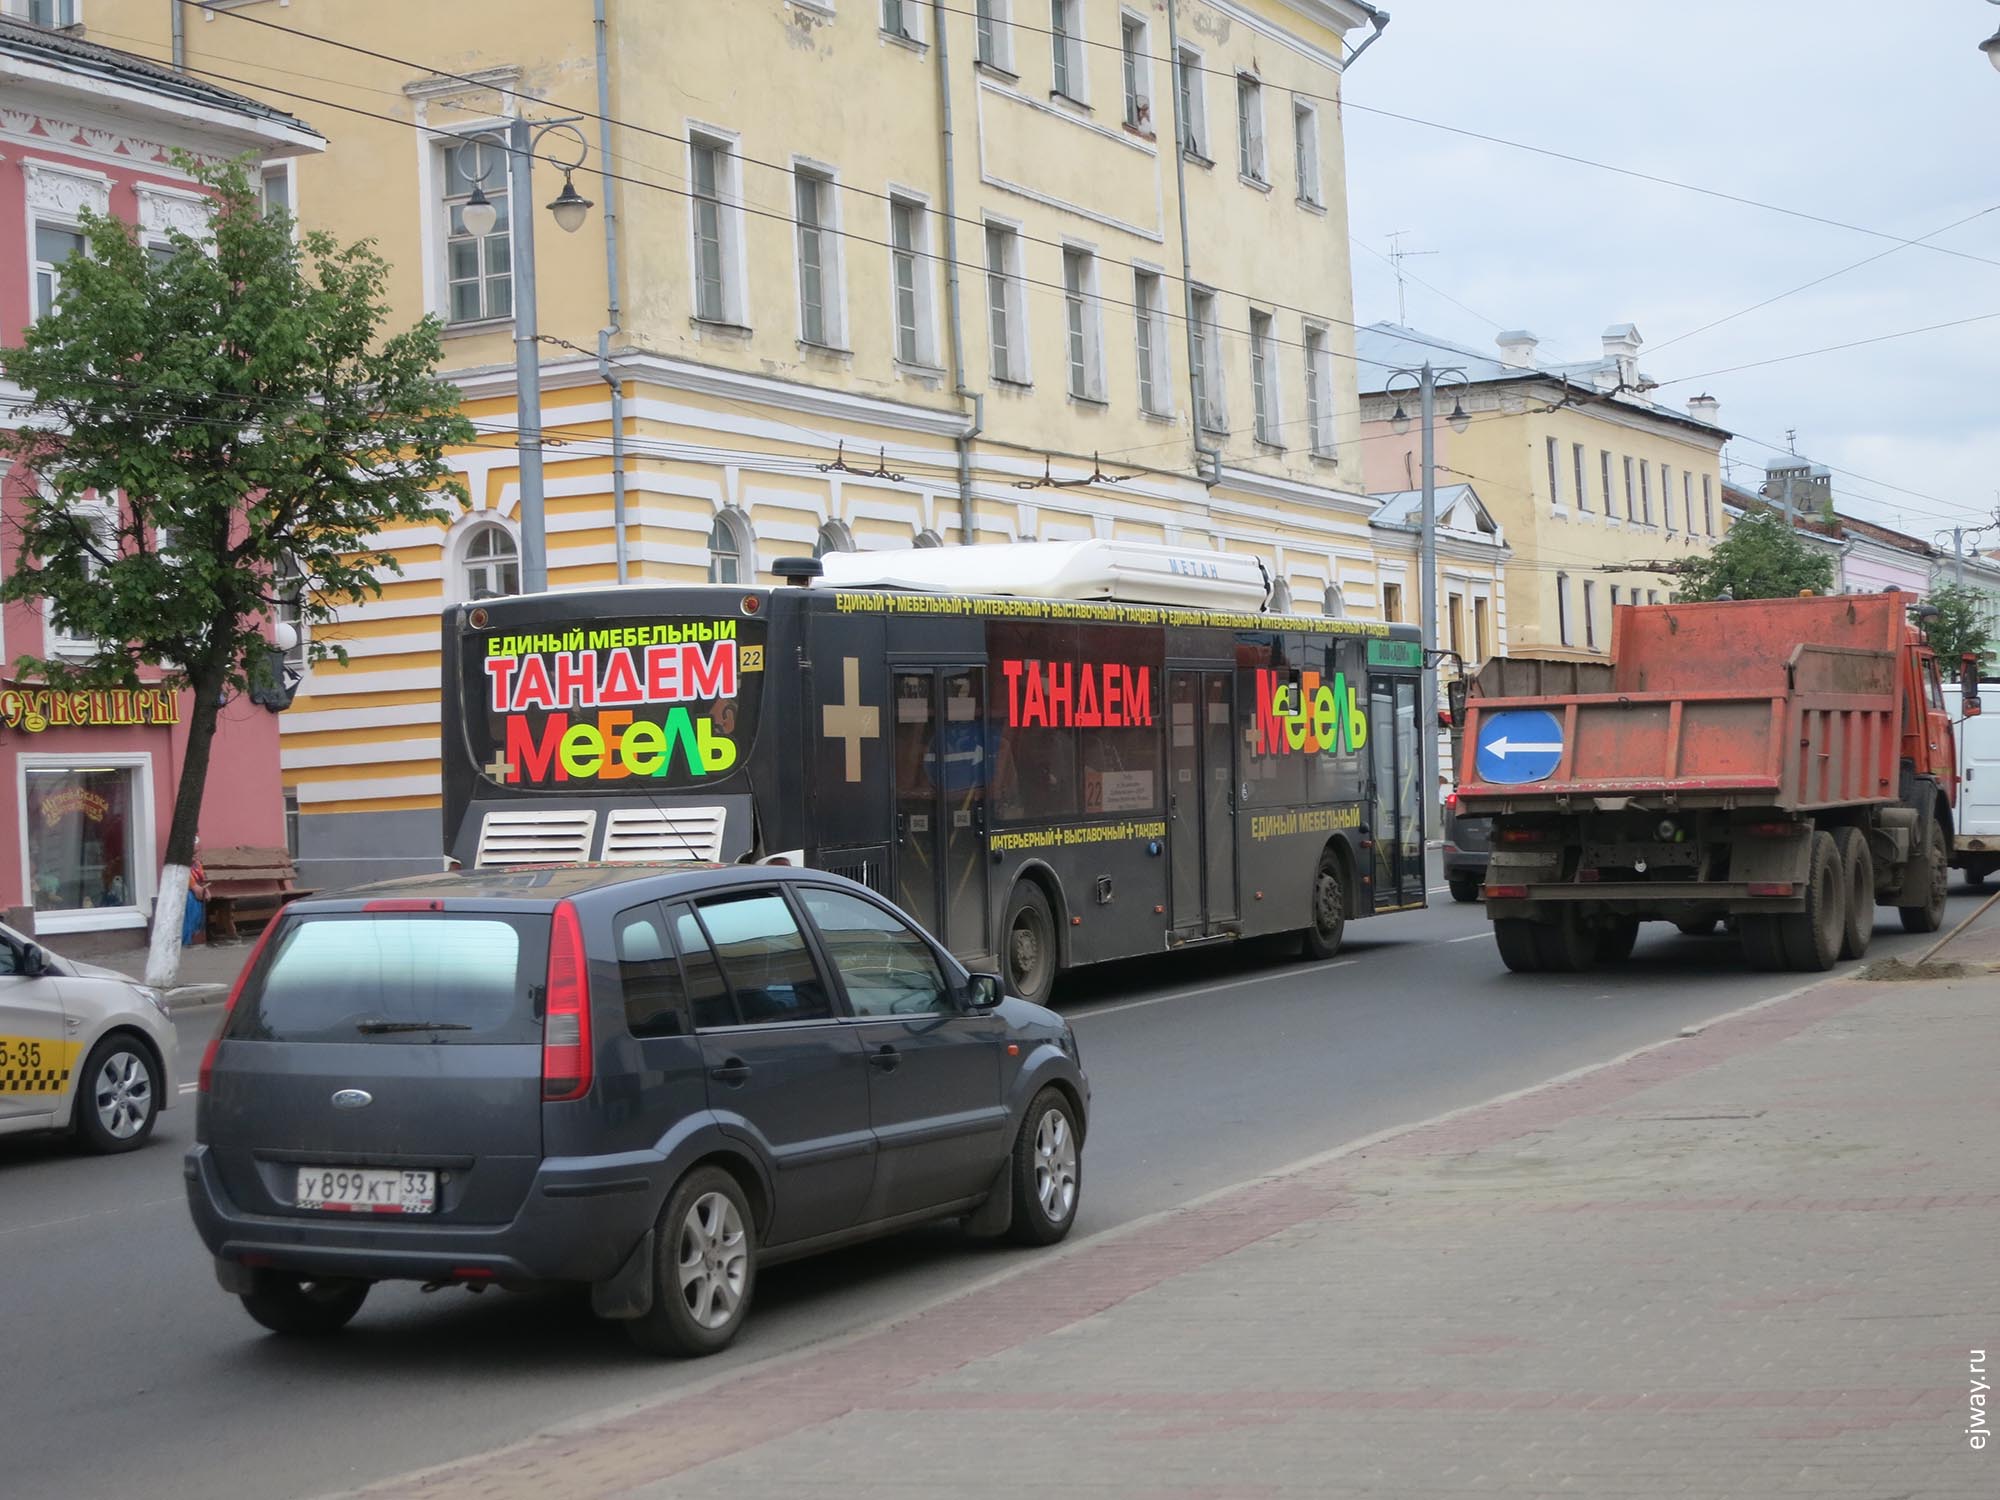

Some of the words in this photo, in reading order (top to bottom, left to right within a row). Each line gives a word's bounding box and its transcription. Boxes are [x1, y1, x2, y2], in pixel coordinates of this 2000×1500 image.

[1168, 558, 1218, 579] МЕТАН
[488, 628, 585, 657] ЕДИНЫЙ
[590, 620, 736, 650] МЕБЕЛЬНЫЙ
[485, 639, 738, 712] ТАНДЕМ
[742, 651, 761, 666] 22
[1003, 660, 1152, 727] ТАНДЕМ
[990, 828, 1054, 851] ИНТЕРЬЕРНЫЙ
[1064, 823, 1125, 844] ВЫСТАВОЧНЫЙ
[1134, 822, 1166, 839] ТАНДЕМ
[1251, 810, 1297, 841] ЕДИНЫЙ
[1301, 804, 1360, 833] МЕБЕЛЬНЫЙ
